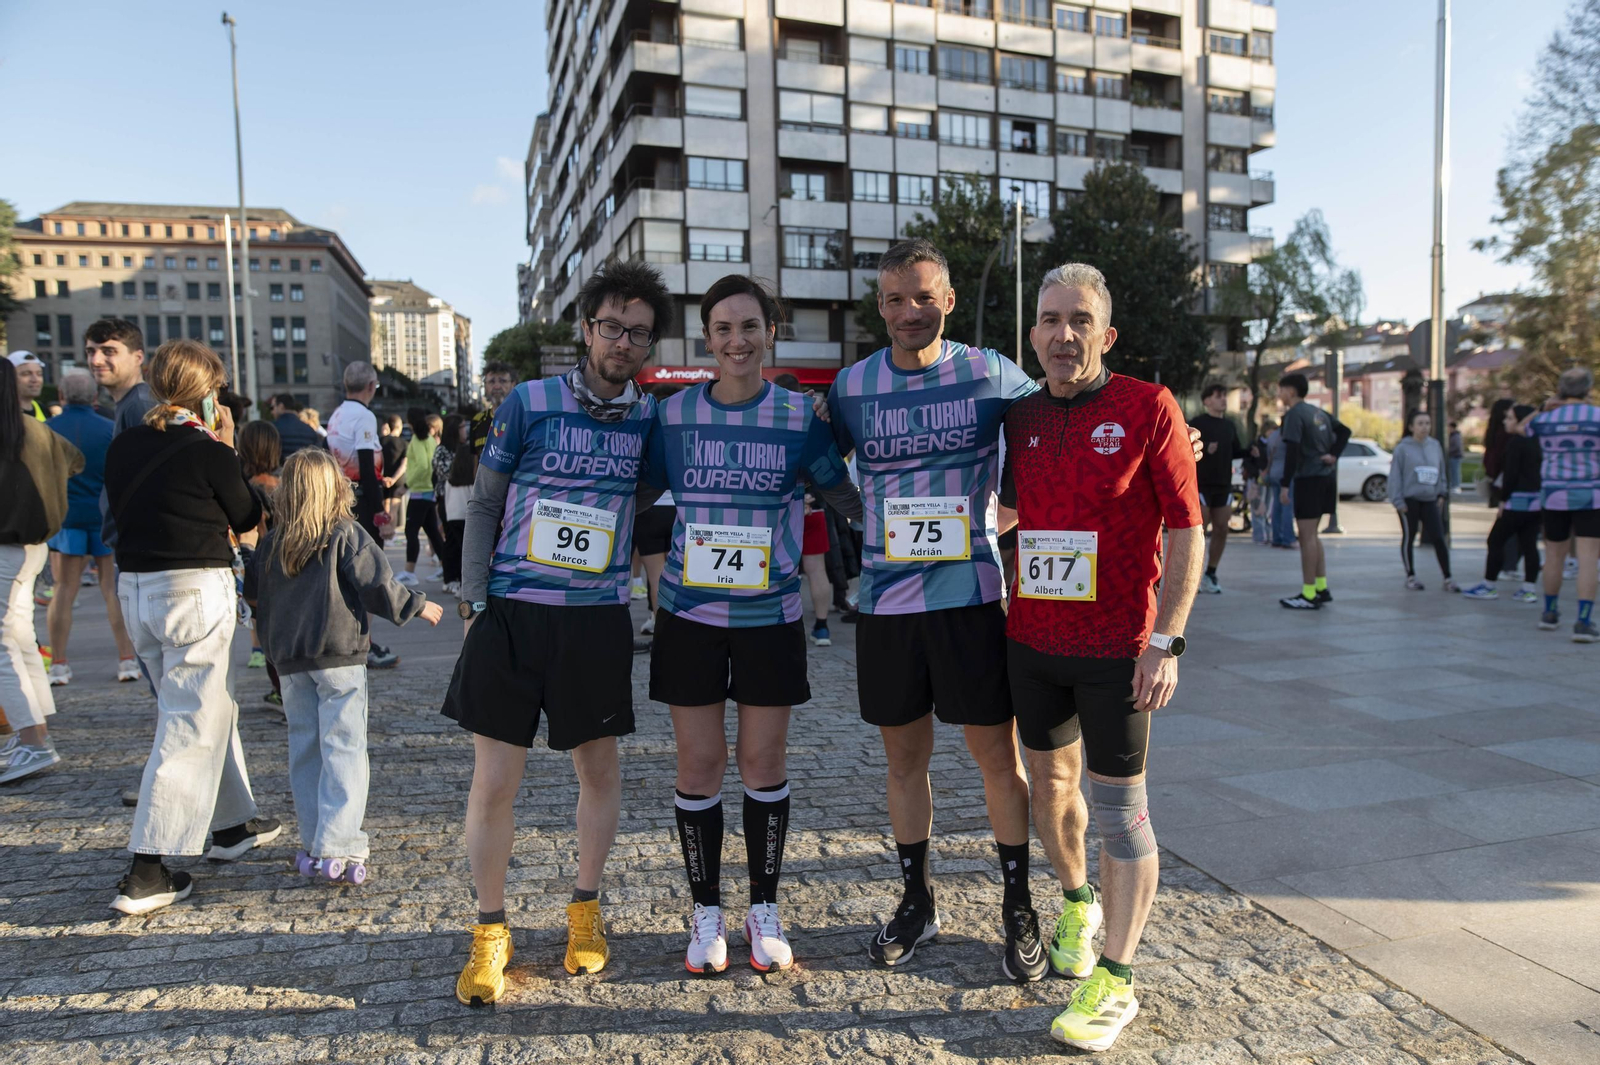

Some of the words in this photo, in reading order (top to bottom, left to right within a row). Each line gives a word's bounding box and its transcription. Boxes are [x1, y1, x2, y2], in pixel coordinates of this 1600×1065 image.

[673, 368, 715, 380] mapfre
[864, 427, 977, 459] OURENSE
[541, 452, 640, 479] OURENSE
[683, 468, 785, 492] OURENSE
[579, 510, 593, 518] VELLA
[557, 526, 590, 552] 96
[909, 521, 943, 543] 75
[551, 552, 588, 565] Marcos
[711, 548, 744, 571] 74
[910, 547, 942, 556] Adrián
[717, 575, 734, 583] Iria
[1029, 556, 1077, 582] 617
[1034, 586, 1064, 595] Albert
